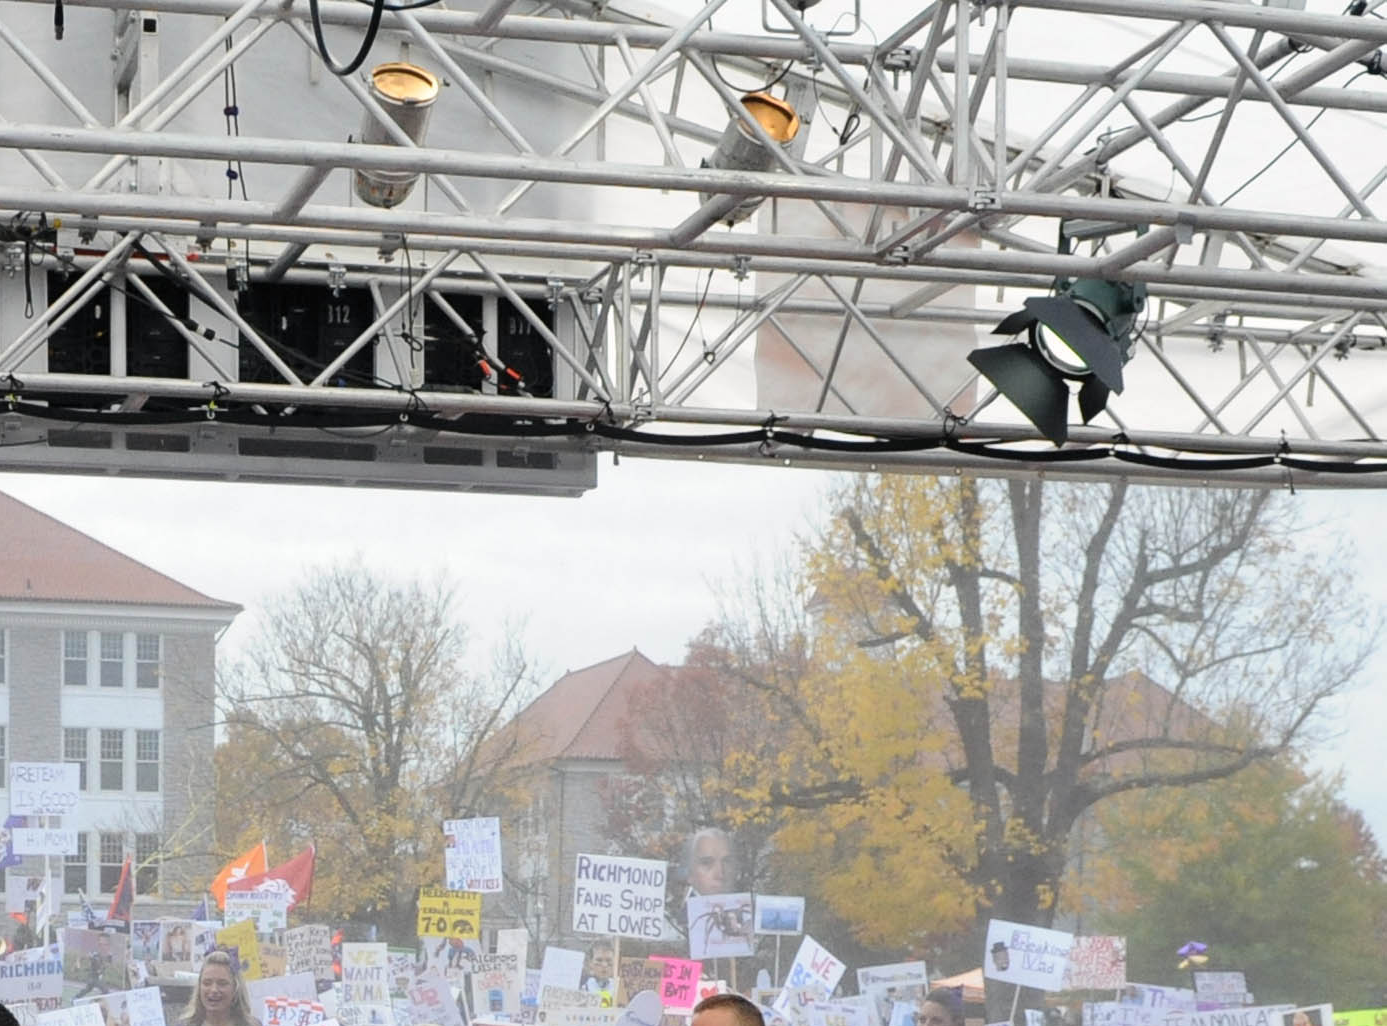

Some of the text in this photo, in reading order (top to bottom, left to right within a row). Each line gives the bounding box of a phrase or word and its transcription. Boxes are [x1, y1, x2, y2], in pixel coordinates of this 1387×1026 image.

[577, 855, 665, 888] RICHMOND
[576, 887, 663, 913] FANS SHOP
[421, 916, 448, 933] 7-0
[576, 914, 663, 937] AT LOWES
[0, 960, 63, 979] RICHMON
[344, 966, 383, 981] WANT
[344, 983, 383, 1002] BAMA
